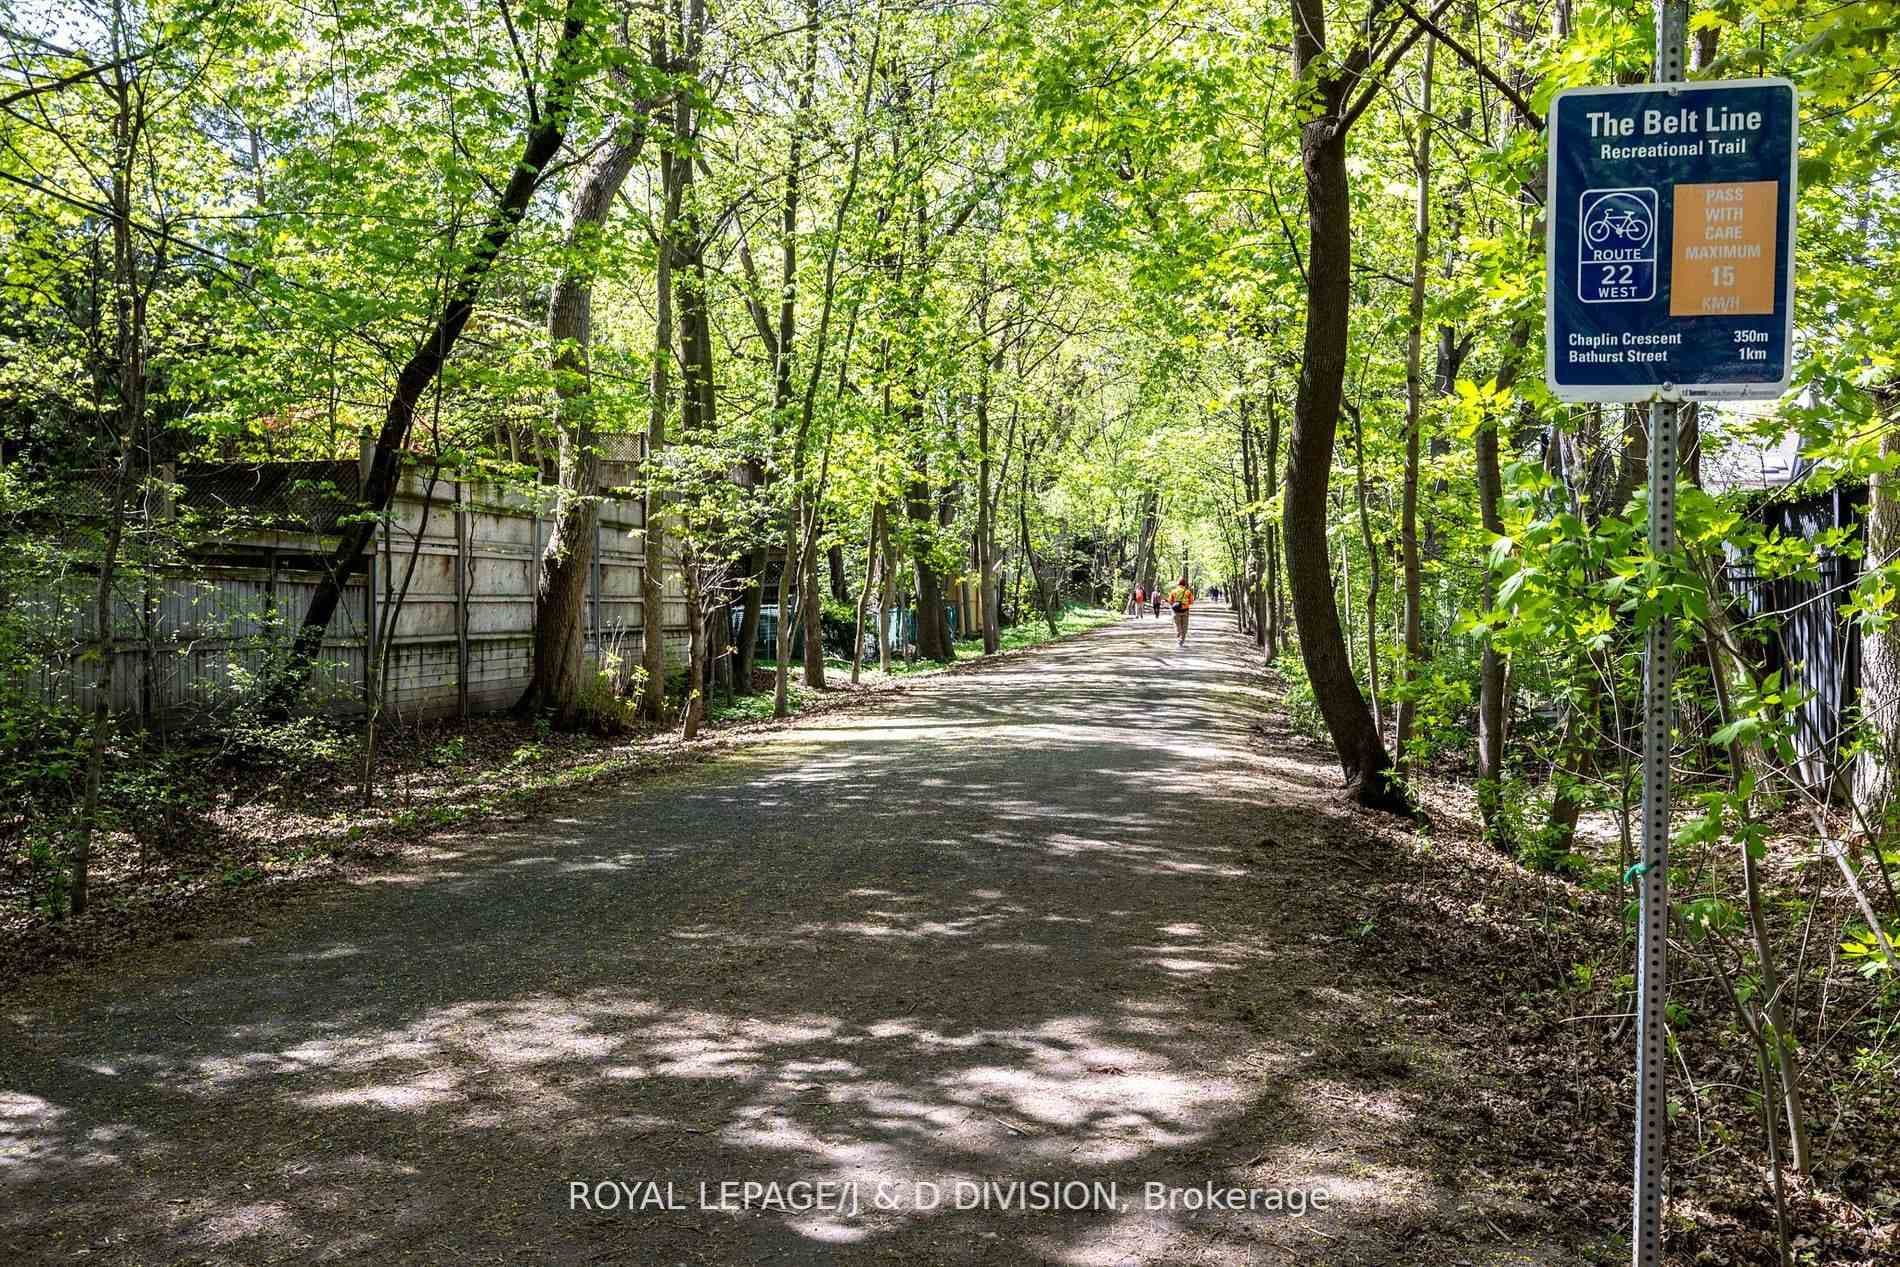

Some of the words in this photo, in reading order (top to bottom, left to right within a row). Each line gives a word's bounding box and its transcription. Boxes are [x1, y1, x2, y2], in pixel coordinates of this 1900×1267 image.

[1587, 112, 1634, 137] The
[1644, 109, 1698, 134] Belt
[1706, 107, 1762, 131] Line
[1601, 141, 1703, 159] Recreational
[1708, 139, 1746, 154] Trail
[1705, 188, 1744, 201] PASS
[1705, 207, 1744, 221] WITH
[1705, 226, 1743, 240] CARE
[1593, 248, 1641, 261] ROUTE
[1685, 245, 1761, 260] MAXIMUM
[1601, 265, 1633, 285] 22
[1712, 266, 1735, 287] 15
[1598, 286, 1638, 298] WEST
[1702, 296, 1740, 311] KM/H
[1568, 332, 1618, 347] Chaplin
[1622, 332, 1682, 345] Crescent
[1733, 330, 1769, 343] 350m
[1569, 350, 1623, 363] Bathurst
[1627, 350, 1668, 362] Street
[1739, 347, 1767, 360] 1km
